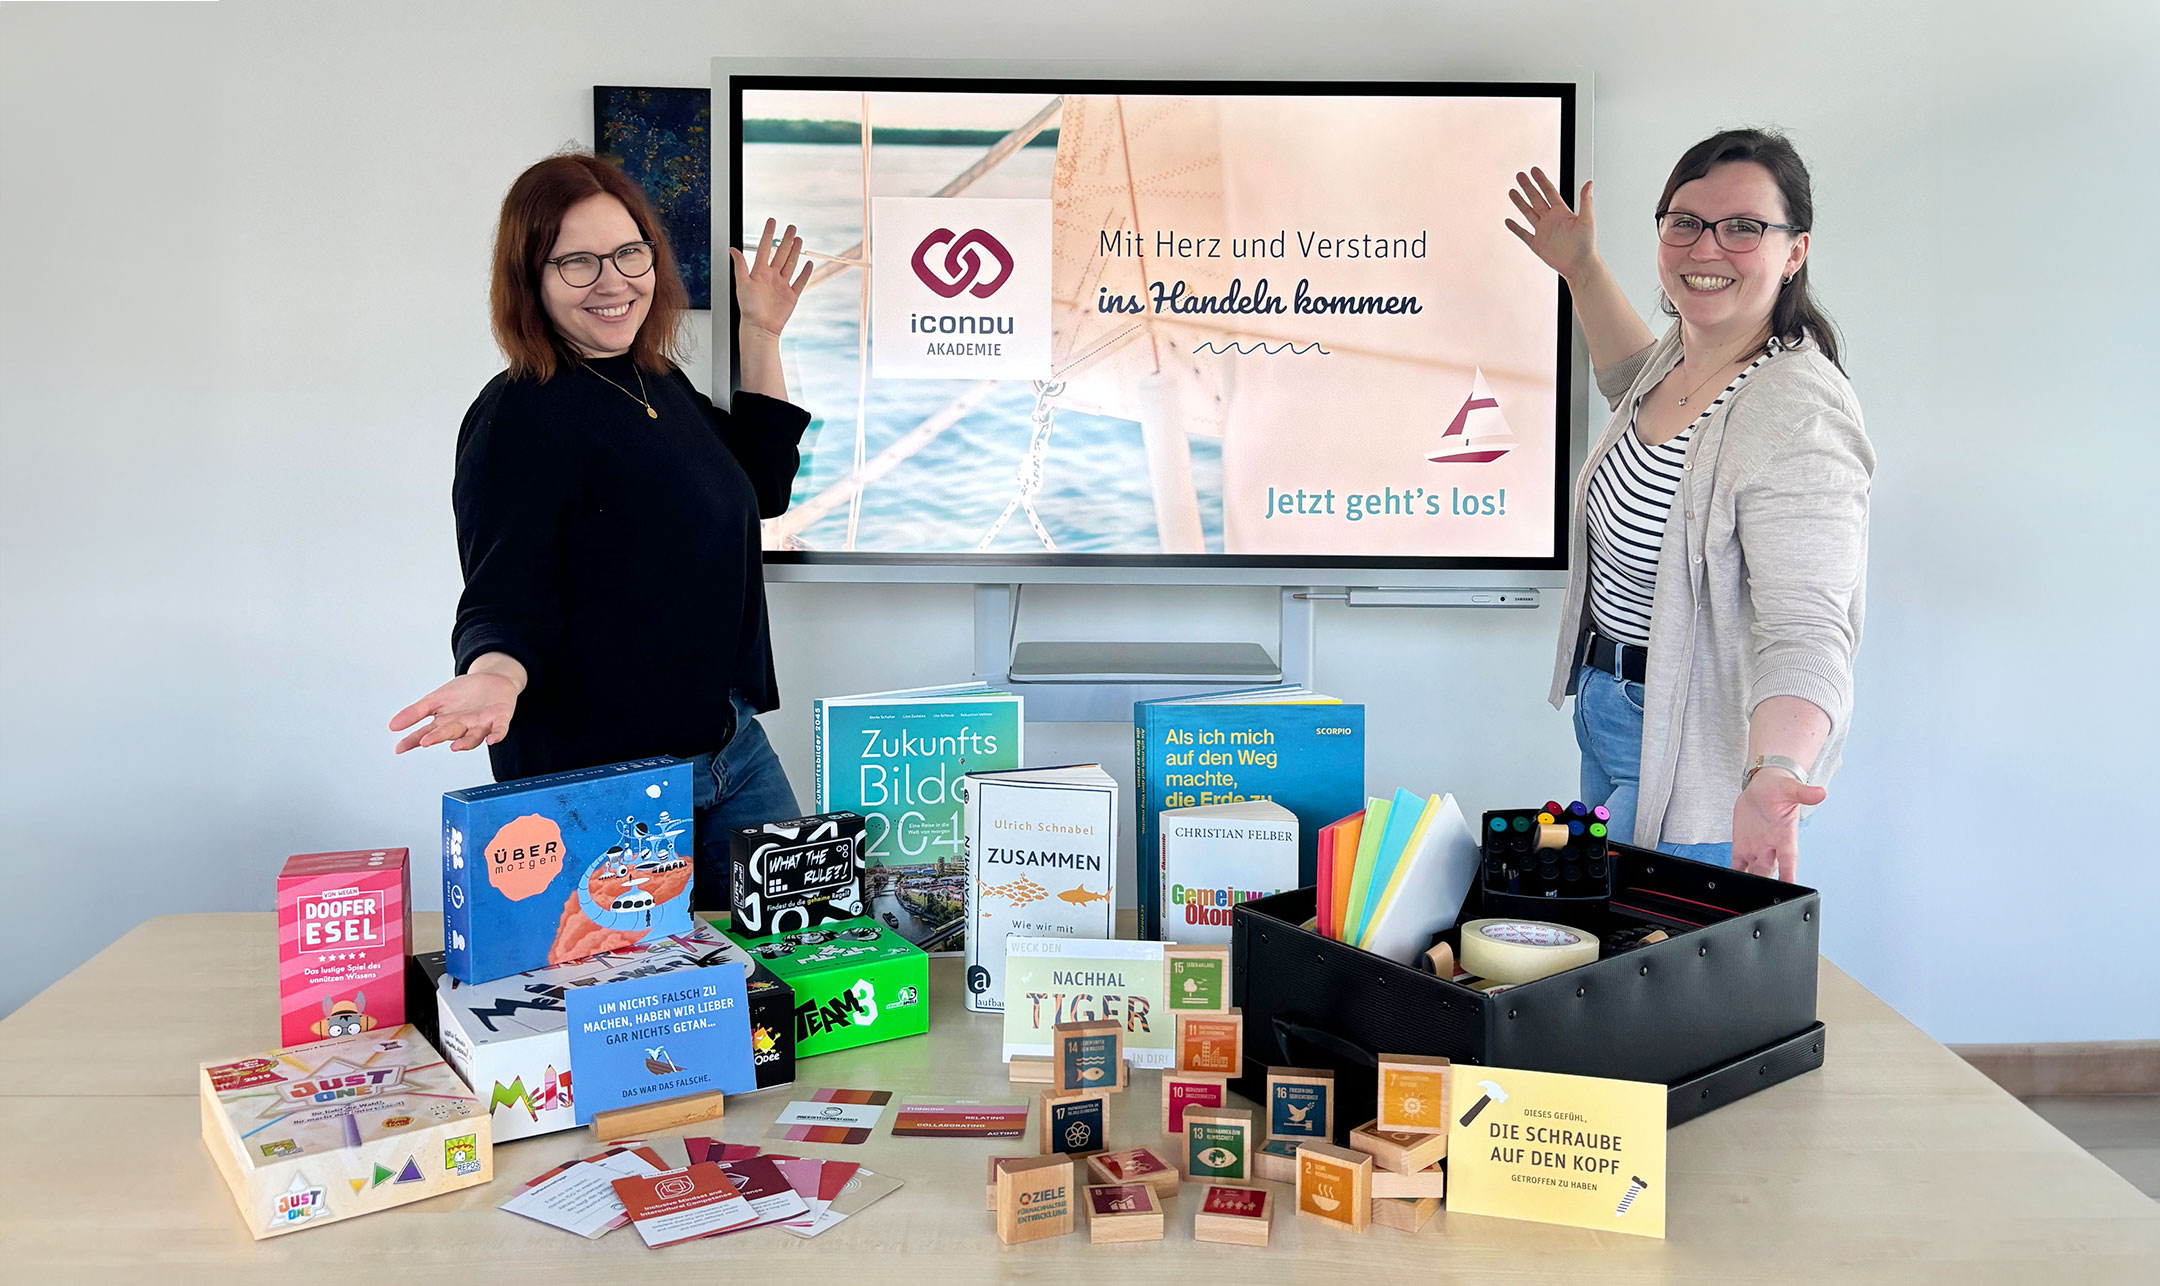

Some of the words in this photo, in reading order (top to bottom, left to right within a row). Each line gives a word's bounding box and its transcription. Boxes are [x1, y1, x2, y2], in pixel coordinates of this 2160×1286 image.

[1100, 230, 1144, 259] Mit
[1156, 230, 1221, 259] Herz
[1232, 230, 1285, 259] und
[1297, 230, 1427, 259] Verstand
[1099, 286, 1144, 315] ins
[1149, 278, 1288, 315] Handeln
[1293, 278, 1423, 315] kommen
[926, 341, 1002, 357] AKADEMIE
[1265, 486, 1335, 520] Jetzt
[1345, 486, 1440, 522] geht's
[1452, 487, 1506, 516] los!
[861, 726, 998, 758] Zukunfts
[1165, 729, 1194, 745] Als
[1198, 729, 1225, 745] ich
[1230, 729, 1275, 745] mich
[1165, 750, 1193, 766] auf
[1198, 750, 1233, 766] den
[1238, 750, 1278, 769] Weg
[860, 762, 964, 806] Bilde
[1165, 770, 1238, 789] machte,
[1165, 791, 1195, 808] die
[1200, 791, 1245, 806] Erde
[864, 811, 964, 857] 204
[994, 819, 1032, 832] Ulrich
[1038, 822, 1094, 836] Schnabel
[1175, 827, 1244, 840] CHRISTIAN
[1248, 829, 1294, 842] FELBER
[494, 841, 558, 864] ÜBER
[769, 852, 804, 874] WHAT
[805, 848, 830, 867] THE
[987, 847, 1101, 872] ZUSAMMEN
[495, 854, 557, 874] morgen
[804, 861, 849, 886] RULE?!
[337, 888, 358, 897] WEGEN
[796, 899, 806, 907] die
[806, 894, 831, 905] geheime
[1172, 884, 1281, 907] Gemeinw
[305, 898, 376, 920] DOOFER
[1185, 900, 1233, 926] Ökon
[306, 918, 377, 945] ESEL
[1012, 920, 1032, 931] Wie
[1036, 922, 1052, 932] wir
[1056, 923, 1074, 934] mit
[1011, 942, 1040, 953] WECK
[1042, 943, 1062, 953] DEN
[304, 967, 319, 976] Das
[321, 965, 345, 975] lustige
[347, 963, 366, 973] Spiel
[367, 962, 381, 970] des
[345, 971, 377, 981] Wissens
[1174, 962, 1184, 974] 15
[1053, 970, 1126, 987] NACHHAL
[599, 1001, 616, 1016] UM
[619, 994, 659, 1012] NICHTS
[661, 987, 701, 1005] FALSCH
[702, 984, 717, 997] ZU
[584, 1017, 633, 1034] MACHEN,
[635, 1009, 671, 1025] HABEN
[673, 1005, 695, 1019] WIR
[698, 997, 734, 1015] LIEBER
[1026, 992, 1151, 1033] TIGER
[606, 1032, 629, 1045] GAR
[631, 1024, 671, 1042] NICHTS
[1188, 1023, 1197, 1036] 11
[1068, 1041, 1077, 1054] 14
[1132, 1053, 1144, 1063] IN
[290, 1069, 393, 1099] JUST
[622, 1088, 638, 1098] DAS
[639, 1083, 657, 1095] WAR
[658, 1080, 674, 1092] DAS
[675, 1073, 711, 1087] FALSCHE.
[1390, 1073, 1398, 1086] 7
[314, 1085, 373, 1103] ONE
[1173, 1086, 1184, 1098] 10
[1276, 1087, 1287, 1099] 16
[1056, 1108, 1066, 1120] 17
[1524, 1108, 1552, 1119] DIESES
[1554, 1110, 1588, 1124] GEFÜHL,
[1193, 1127, 1204, 1140] 13
[1489, 1122, 1520, 1140] DIE
[1526, 1126, 1622, 1152] SCHRAUBE
[457, 1159, 481, 1172] REPOS
[1305, 1161, 1312, 1175] 2
[1490, 1146, 1525, 1164] AUF
[1531, 1150, 1566, 1170] DEN
[1573, 1155, 1620, 1175] KOPF
[1511, 1174, 1556, 1187] GETROFFEN
[1558, 1178, 1569, 1188] ZU
[1570, 1180, 1598, 1192] HABEN
[278, 1190, 322, 1213] JUST
[644, 1201, 678, 1211] Inclusive
[678, 1193, 708, 1203] Mindset
[708, 1189, 723, 1197] and
[686, 1192, 733, 1207] Competence
[1031, 1186, 1066, 1204] ZIELE
[287, 1207, 312, 1221] ONE
[1017, 1208, 1068, 1225] ENTWICKLUNG
